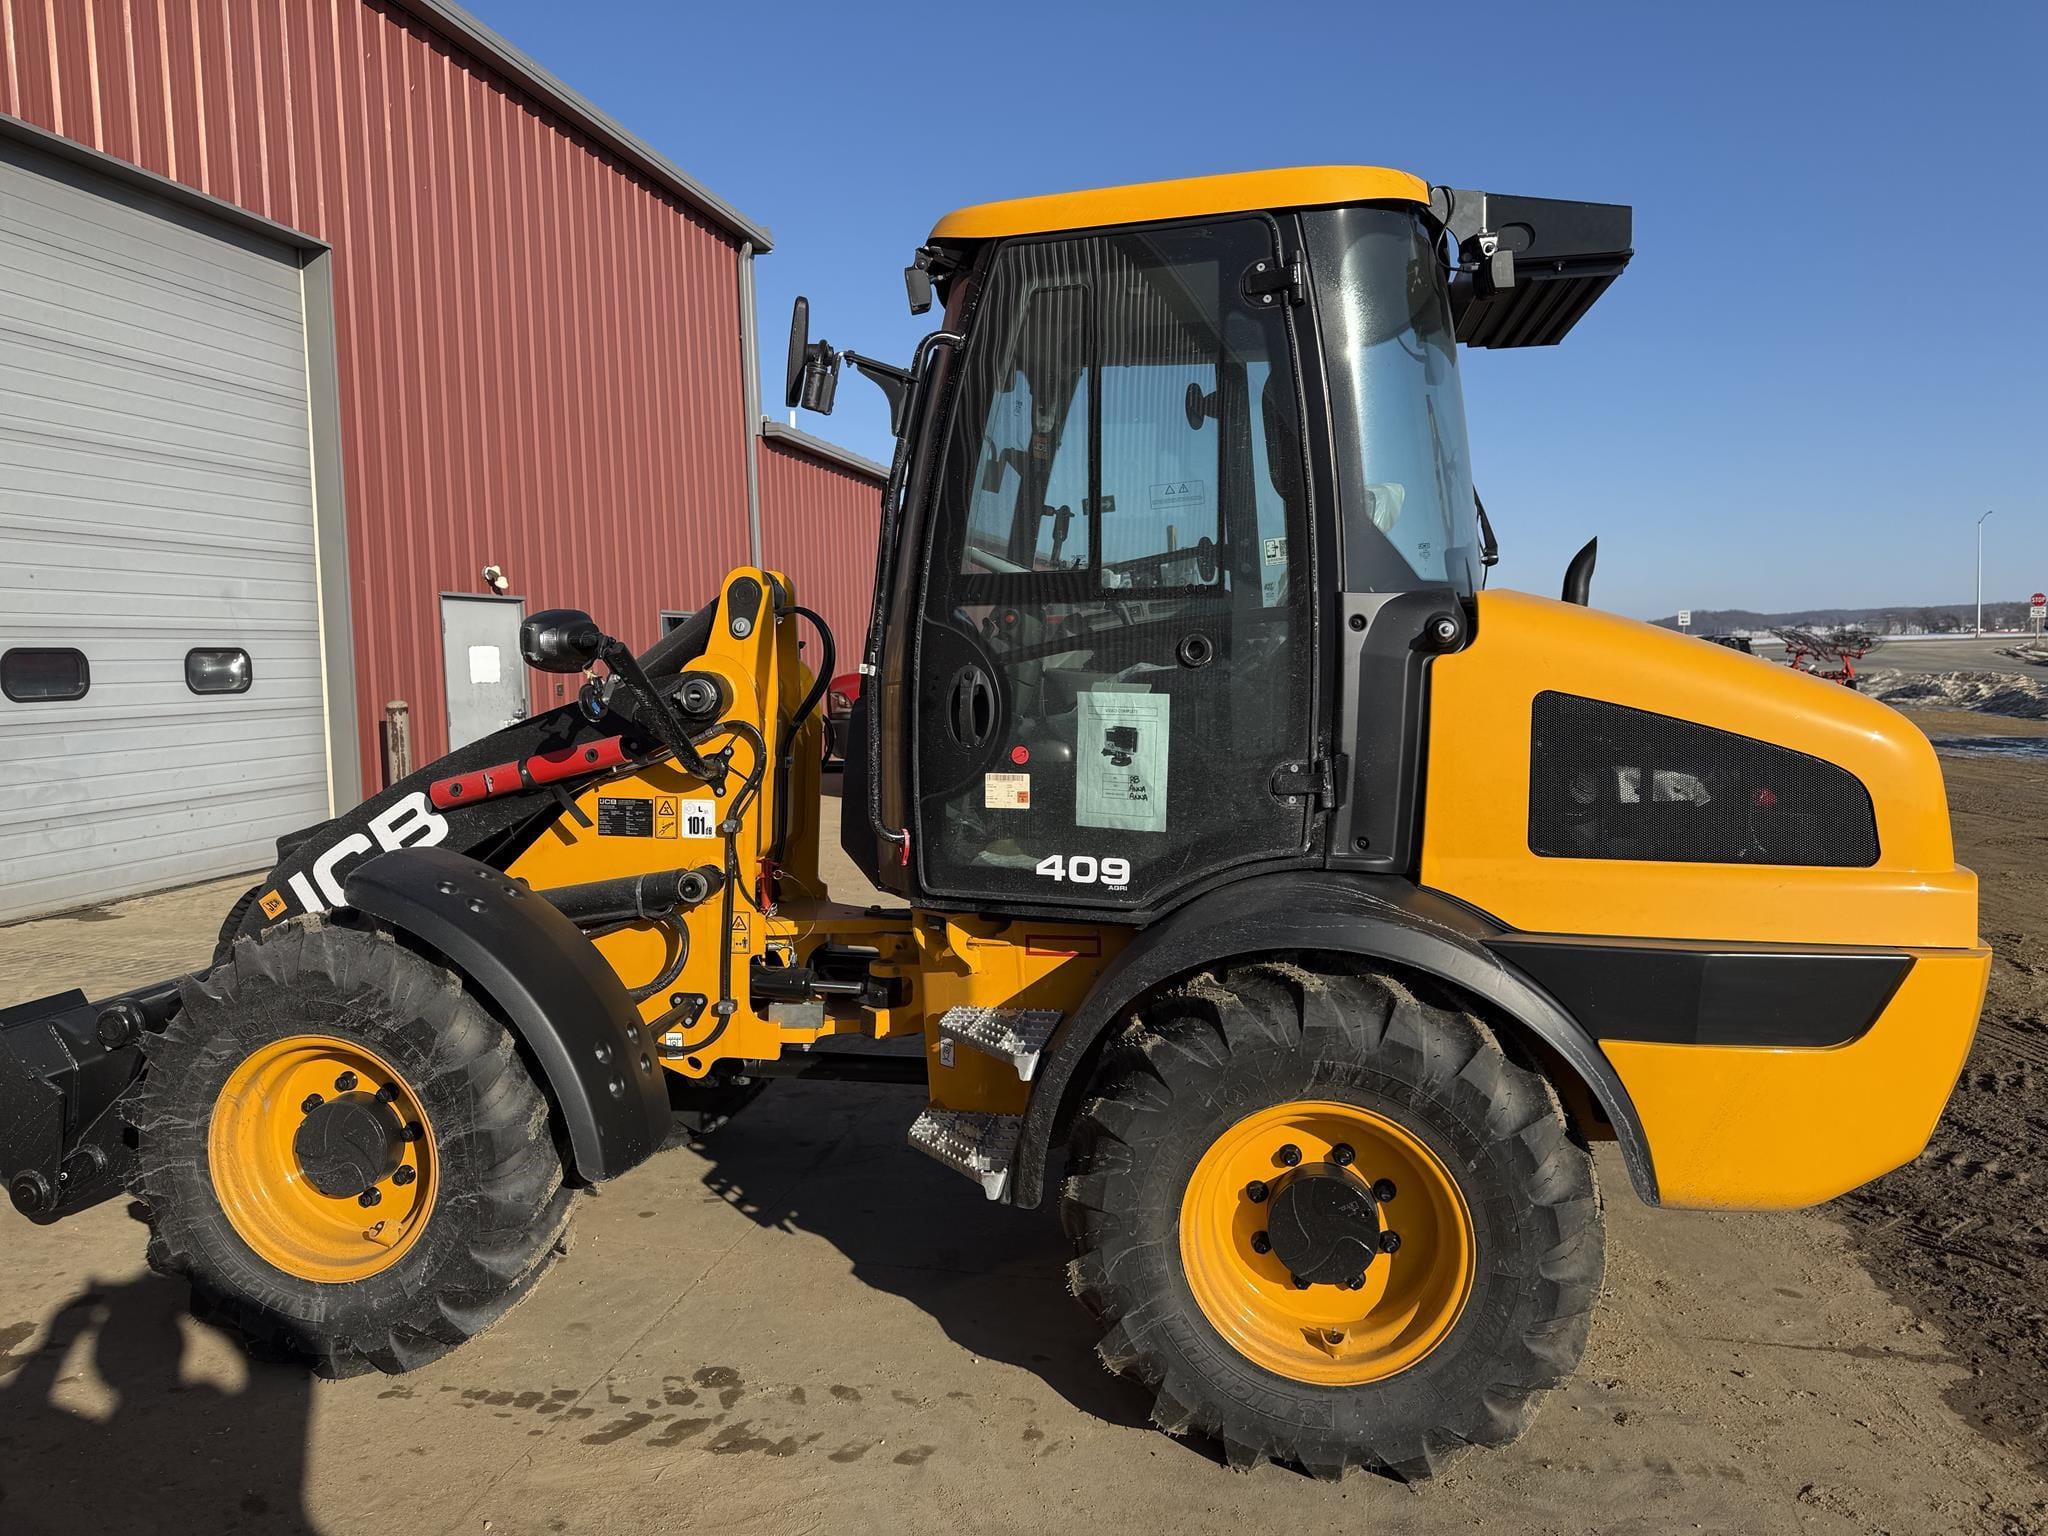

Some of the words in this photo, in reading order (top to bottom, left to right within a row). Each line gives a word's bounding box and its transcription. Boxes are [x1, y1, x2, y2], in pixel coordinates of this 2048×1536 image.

[687, 816, 705, 835] 101
[1036, 855, 1131, 886] 409
[1161, 1314, 1295, 1421] MICHELIN
